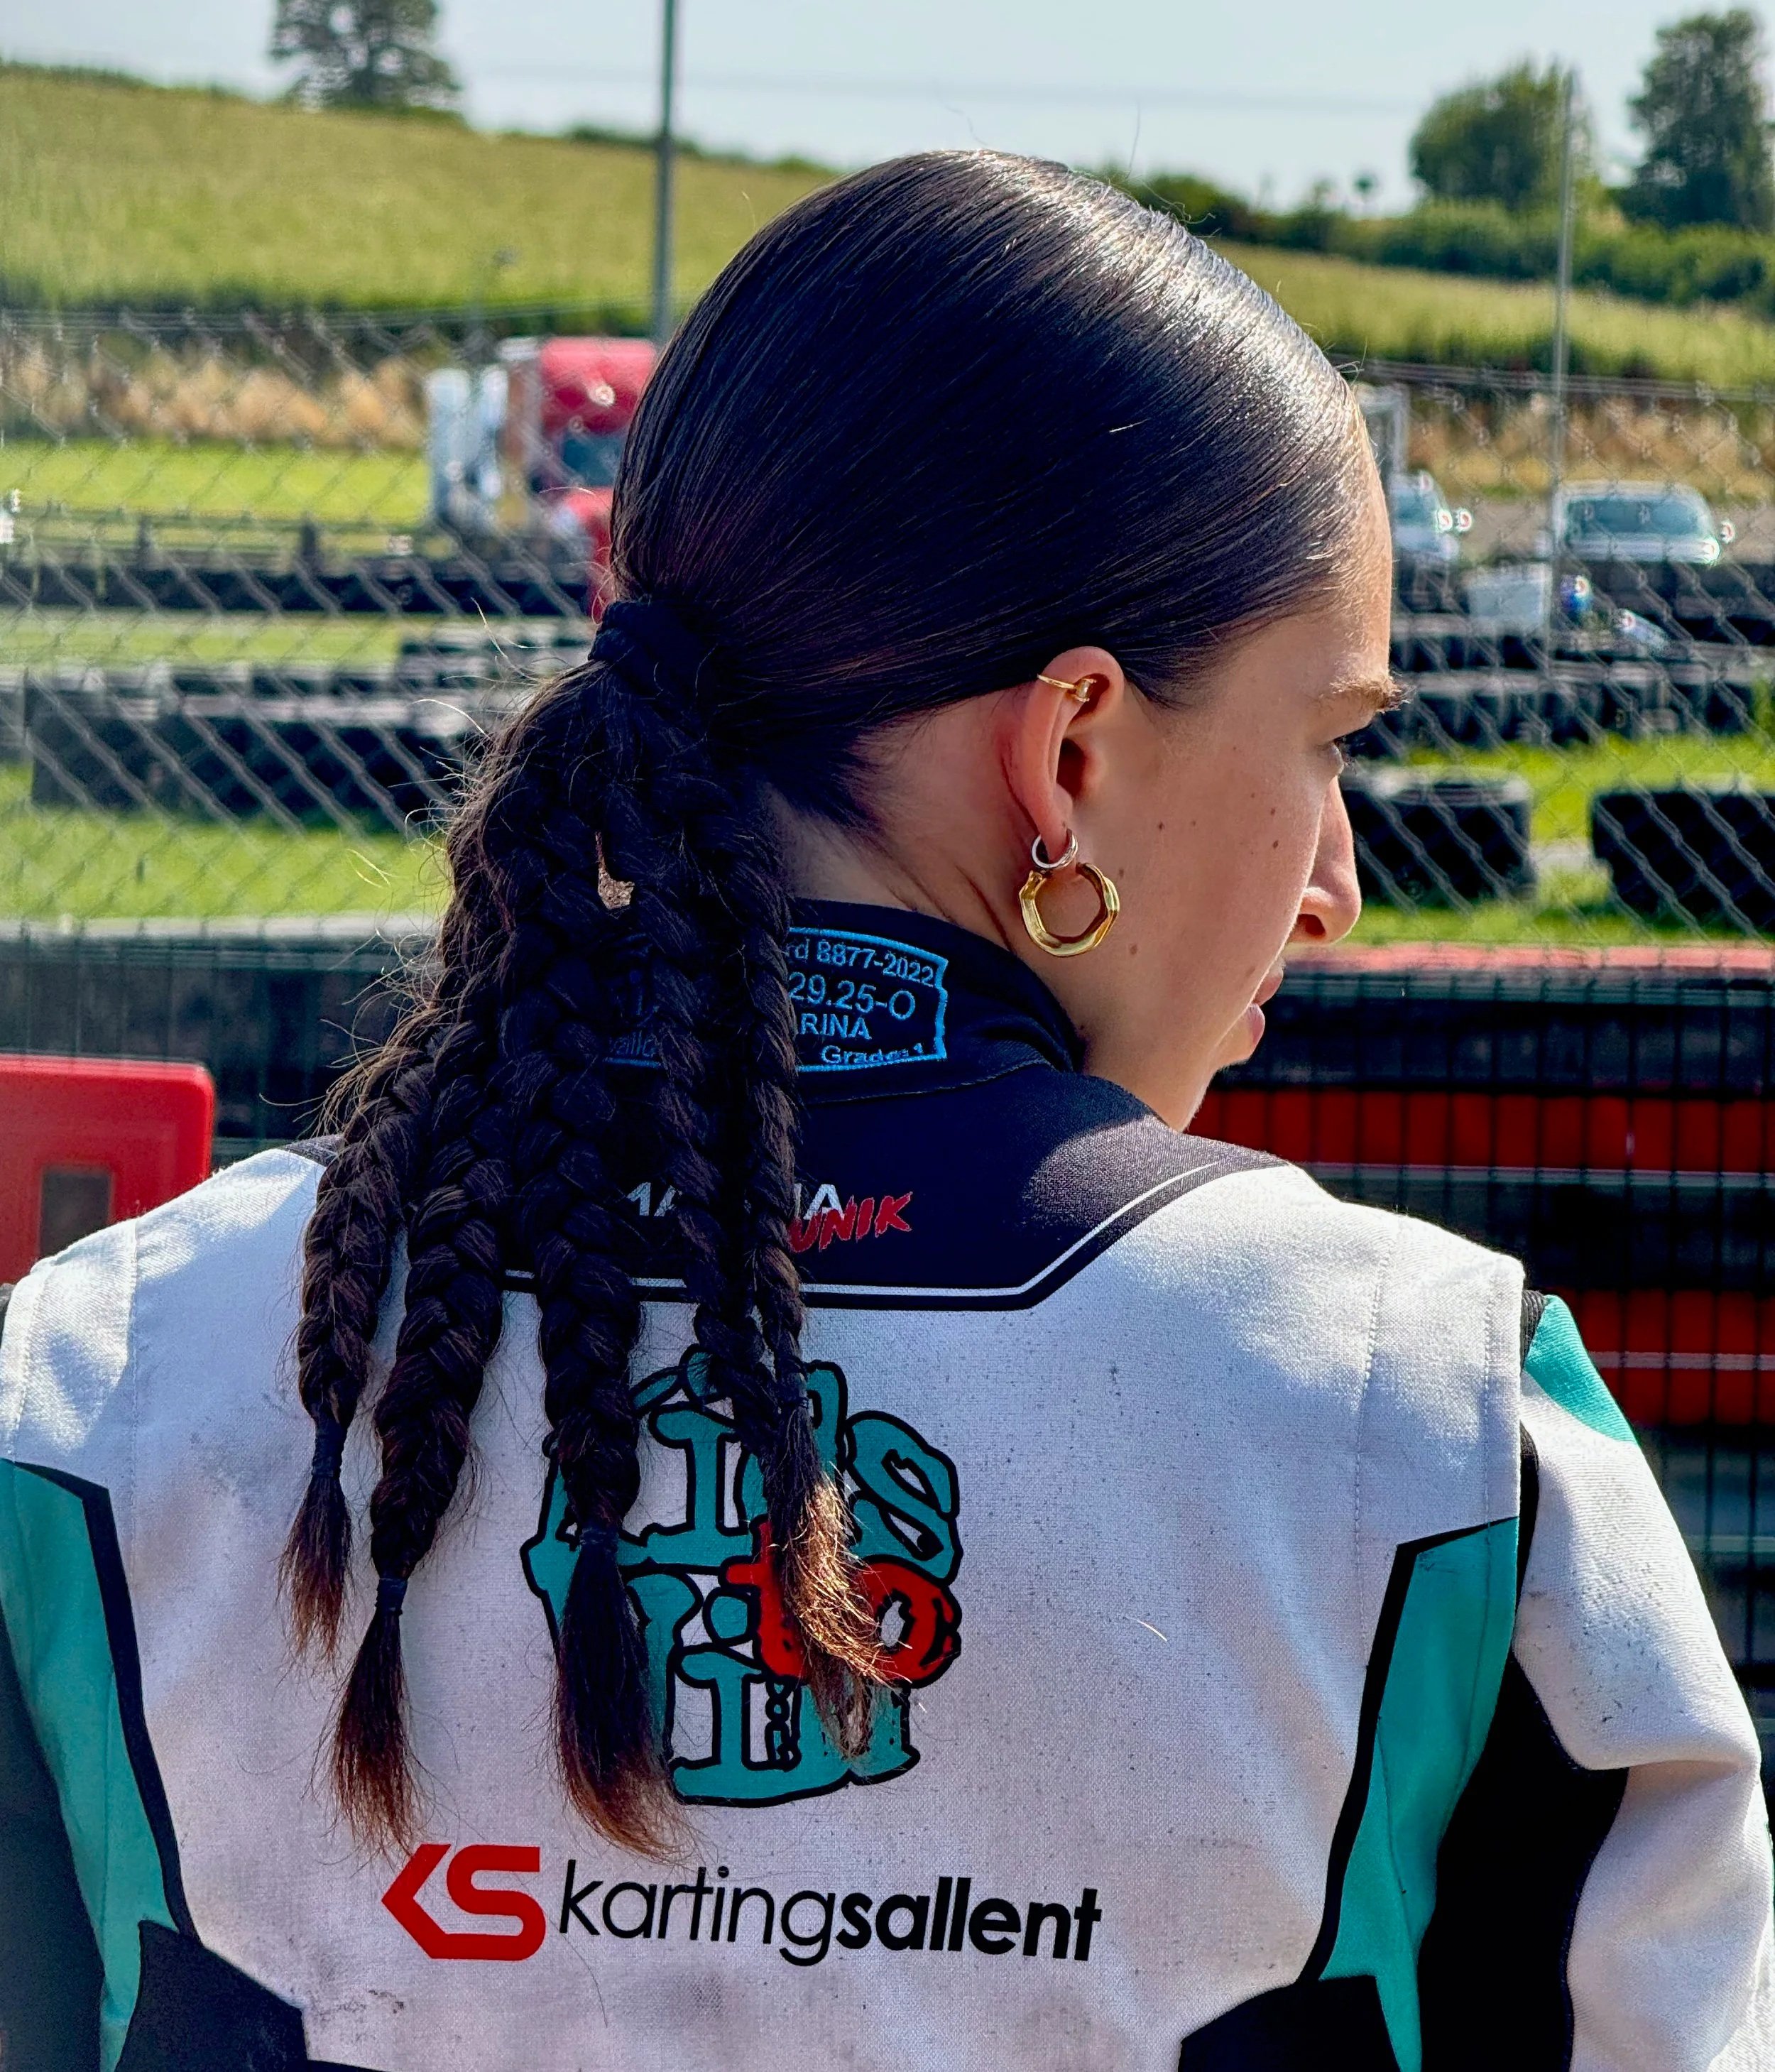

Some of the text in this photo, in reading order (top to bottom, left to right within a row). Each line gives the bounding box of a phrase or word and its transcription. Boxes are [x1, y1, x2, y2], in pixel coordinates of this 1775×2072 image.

[816, 939, 934, 988] 8877-2022
[800, 1013, 872, 1040] RINA
[788, 1191, 914, 1254] UNIK
[559, 1859, 1102, 1967] kartingsallent
